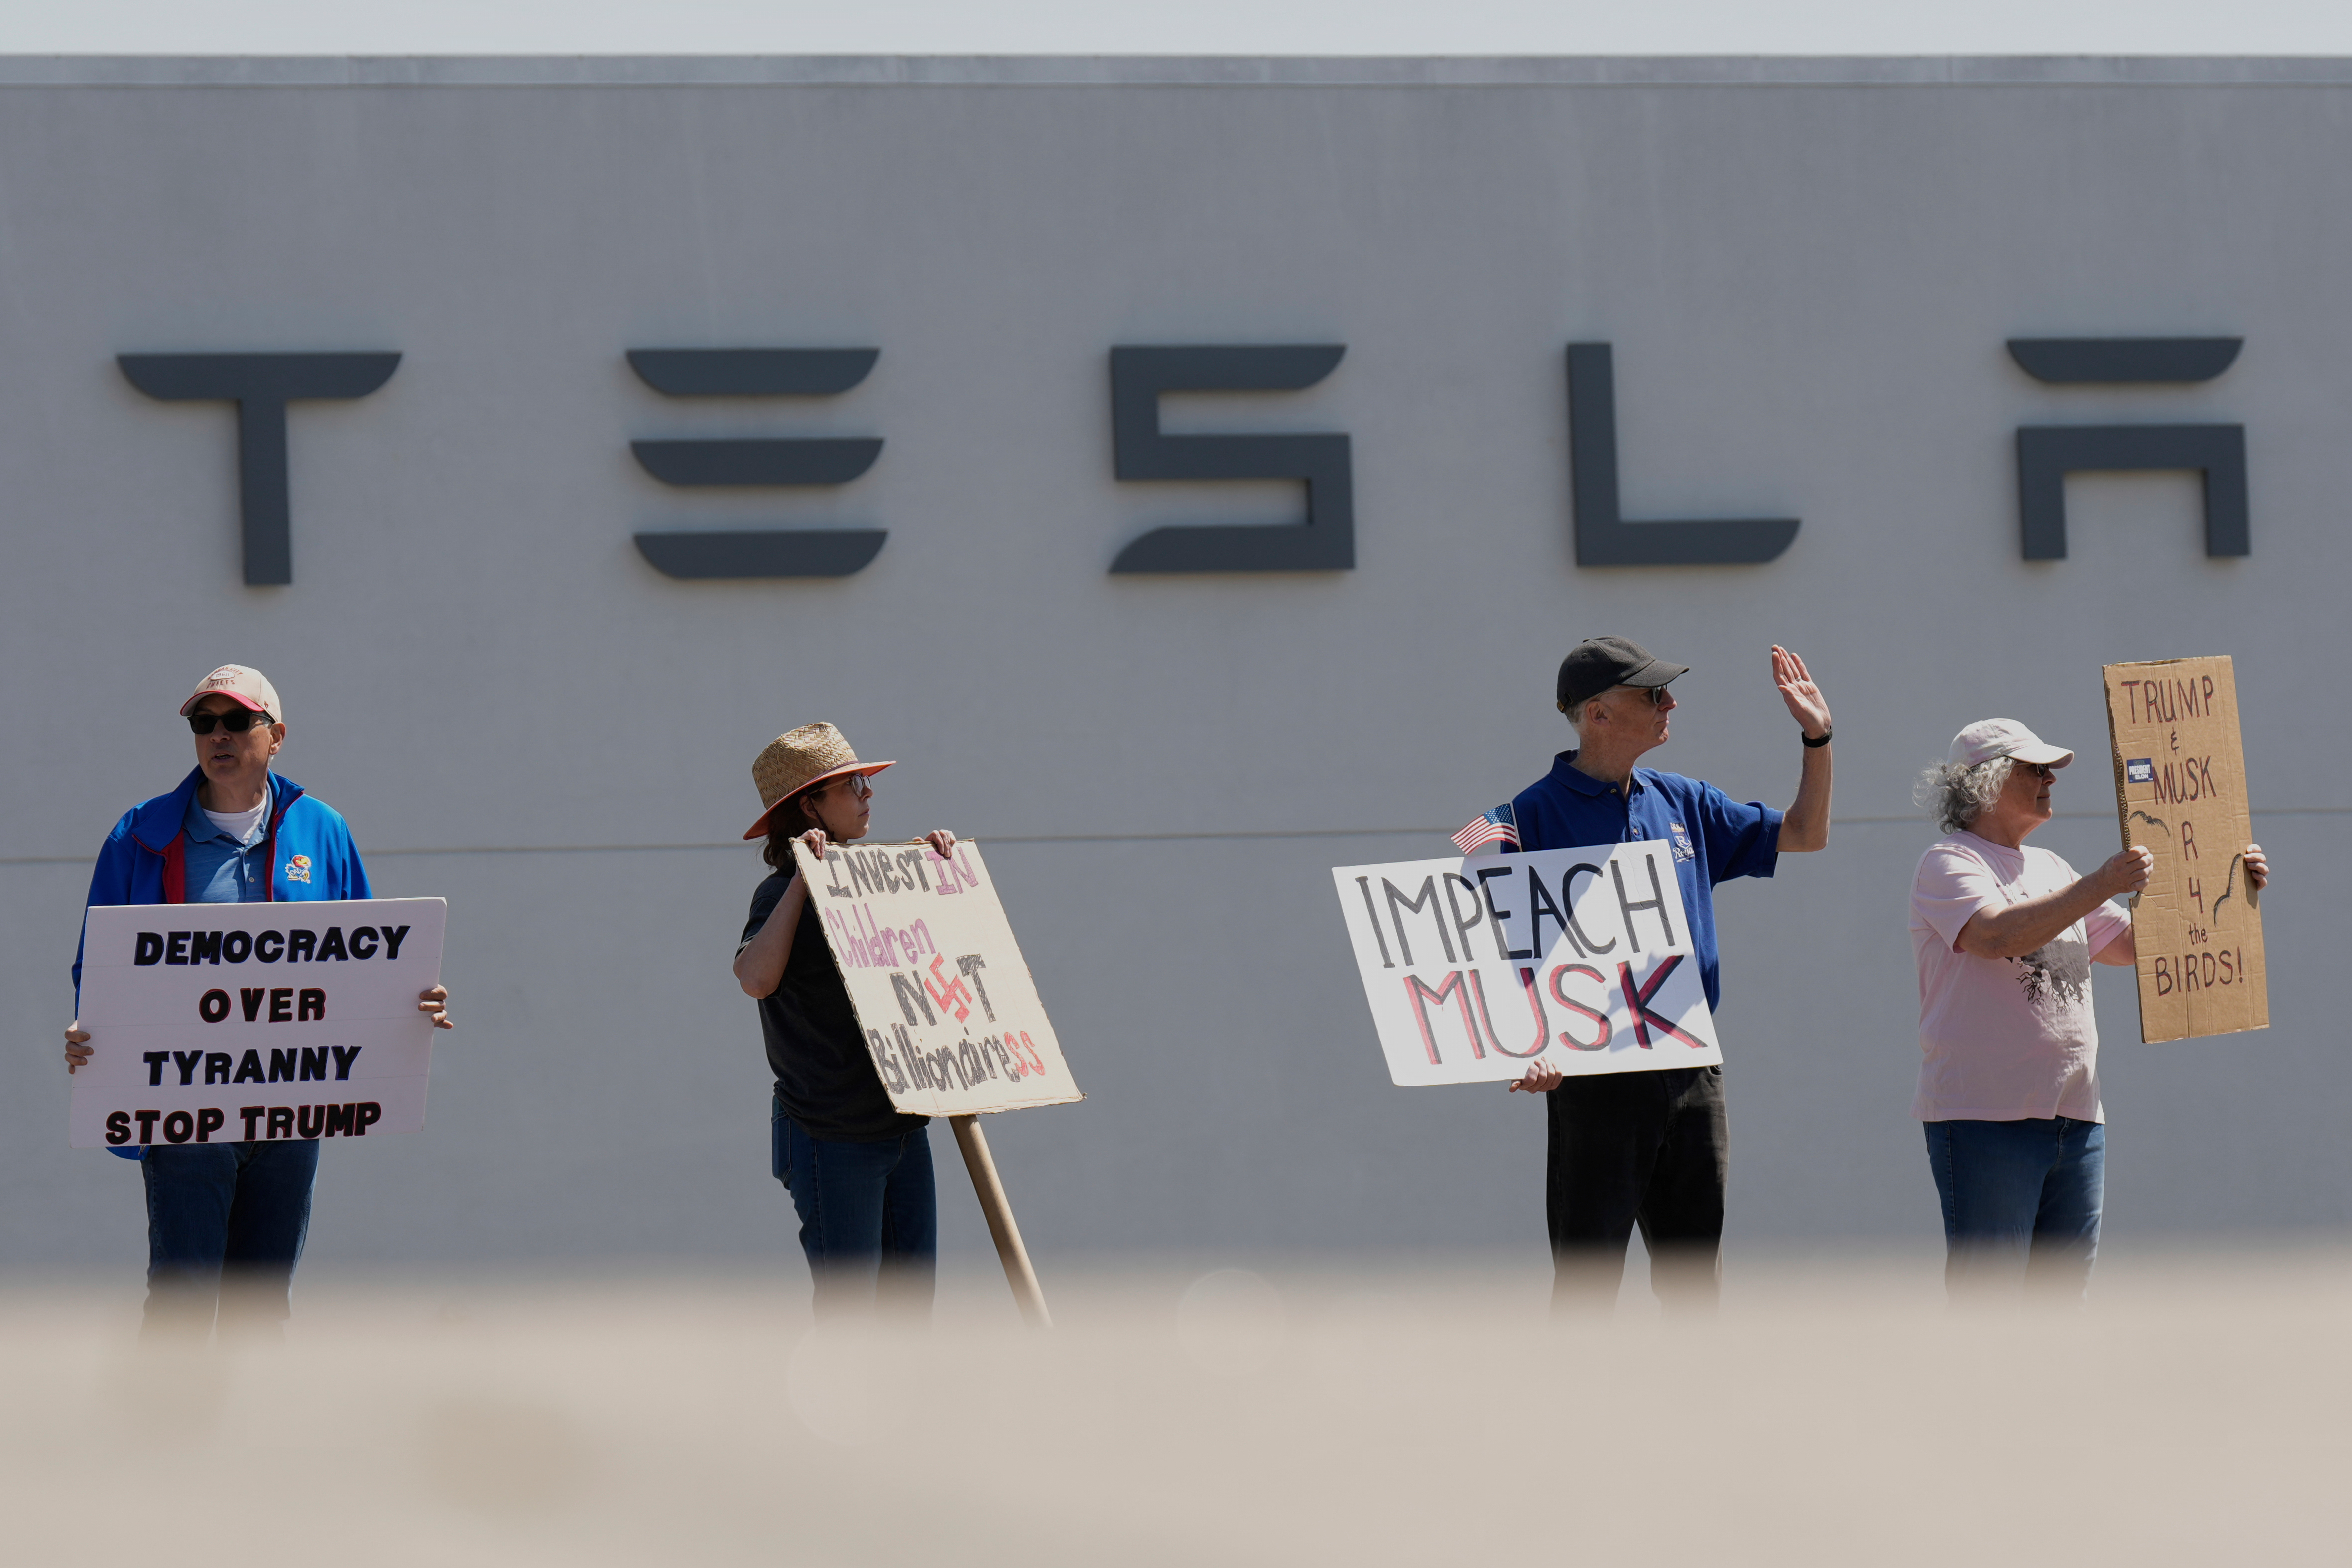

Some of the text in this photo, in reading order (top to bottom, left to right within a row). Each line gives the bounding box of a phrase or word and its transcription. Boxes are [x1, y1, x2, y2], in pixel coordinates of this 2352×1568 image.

[116, 336, 2250, 586] TESLA
[206, 680, 235, 689] CHIEFS
[2121, 674, 2214, 724] TRUMP
[2170, 727, 2179, 756] &
[2129, 764, 2151, 775] PRESIDENT
[2151, 755, 2217, 805] MUSK
[1673, 847, 1694, 859] Roya
[1675, 836, 1689, 845] R
[2181, 821, 2198, 861] R
[924, 846, 979, 895] IN
[1355, 853, 1676, 969] IMPEACH
[2189, 878, 2204, 914] 4
[134, 925, 411, 965] DEMOCRACY
[825, 903, 937, 968] Children
[2188, 923, 2208, 945] the
[889, 952, 996, 1027] NT
[2155, 945, 2243, 996] BIRDS!
[199, 987, 327, 1023] OVER
[1403, 955, 1708, 1065] MUSK
[143, 1046, 362, 1086] TYRANNY
[105, 1101, 381, 1144] STOP TRUMP
